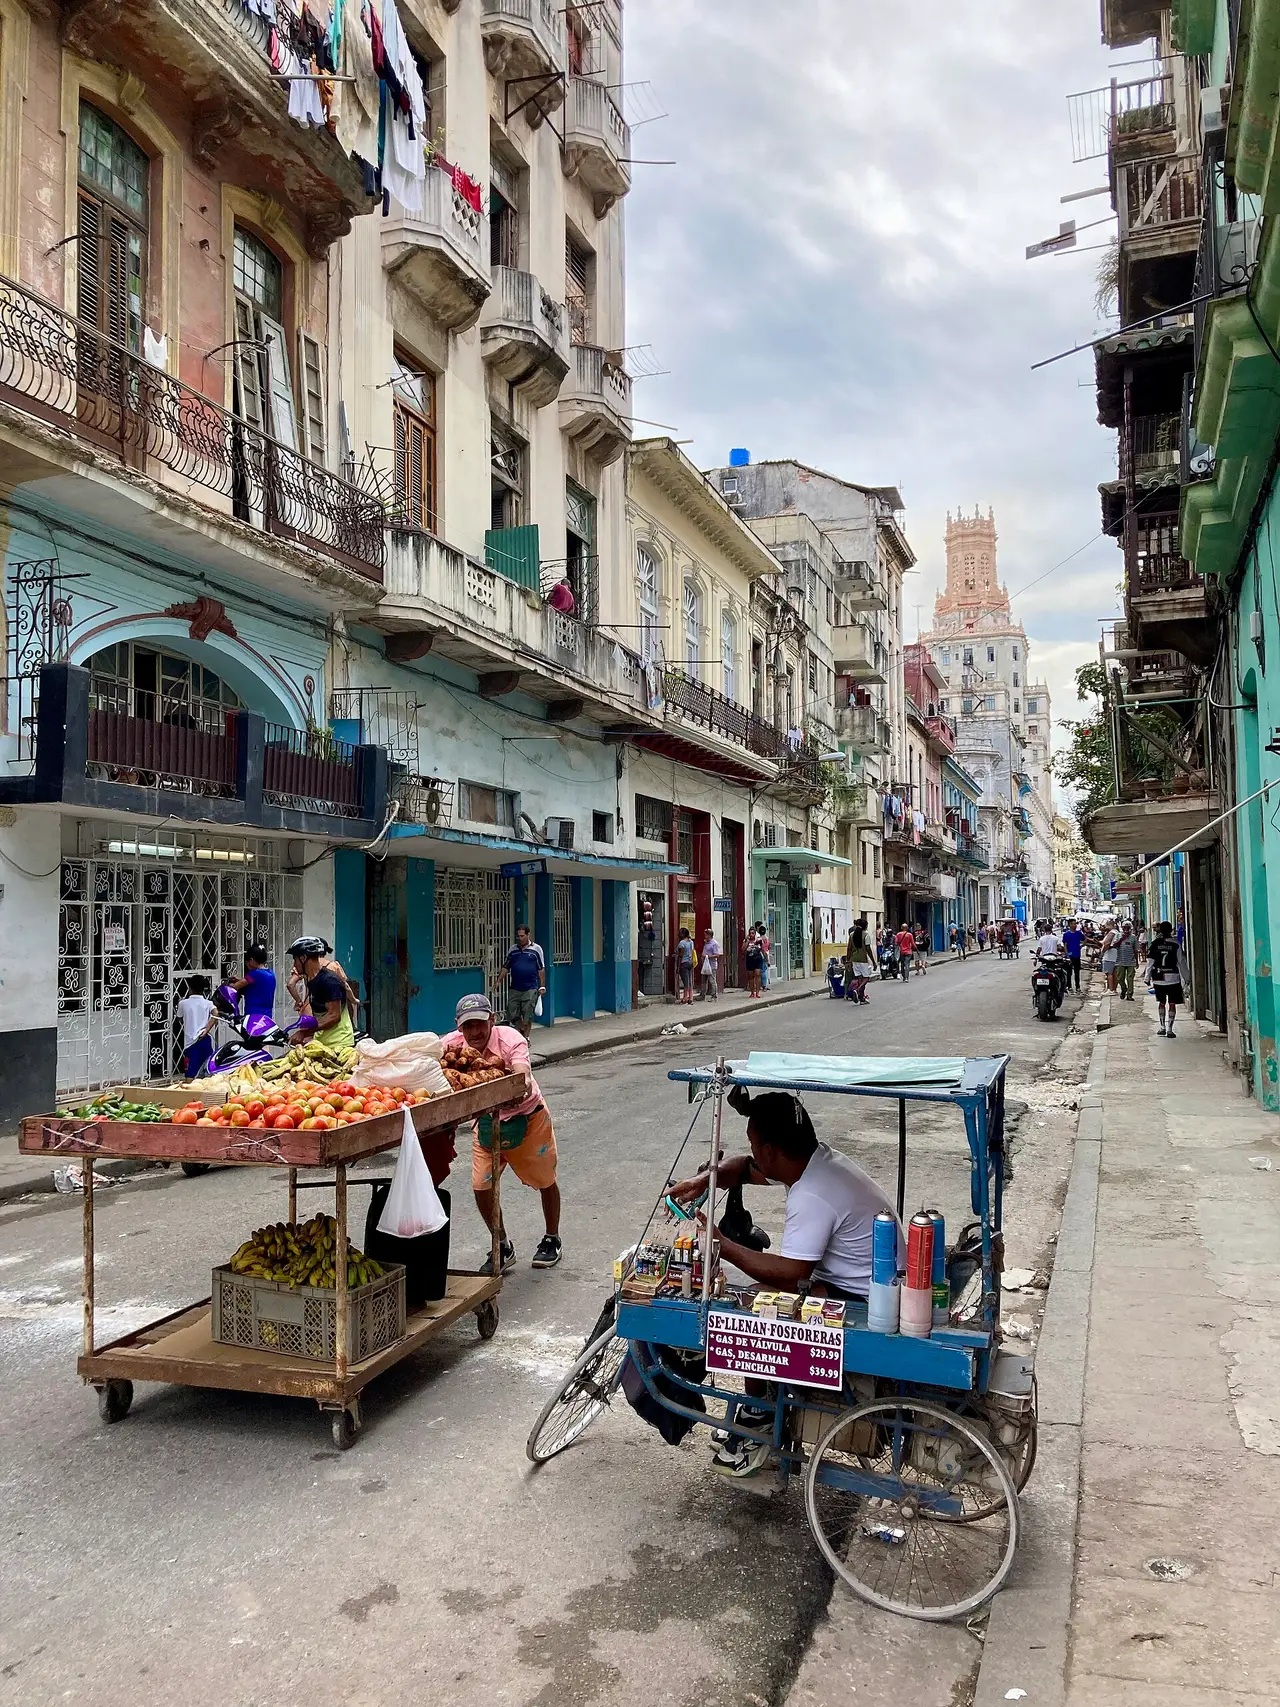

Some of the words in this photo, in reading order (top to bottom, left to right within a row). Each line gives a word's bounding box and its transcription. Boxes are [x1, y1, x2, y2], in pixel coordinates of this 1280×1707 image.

[1161, 951, 1168, 966] 7
[715, 1334, 734, 1345] GAS
[735, 1337, 748, 1347] DE
[715, 1347, 736, 1359] GAS,
[738, 1350, 789, 1366] DESARMAR
[810, 1347, 840, 1361] $29.99
[726, 1359, 733, 1368] Y
[735, 1360, 776, 1375] PINCHAR
[809, 1365, 839, 1379] $39.99
